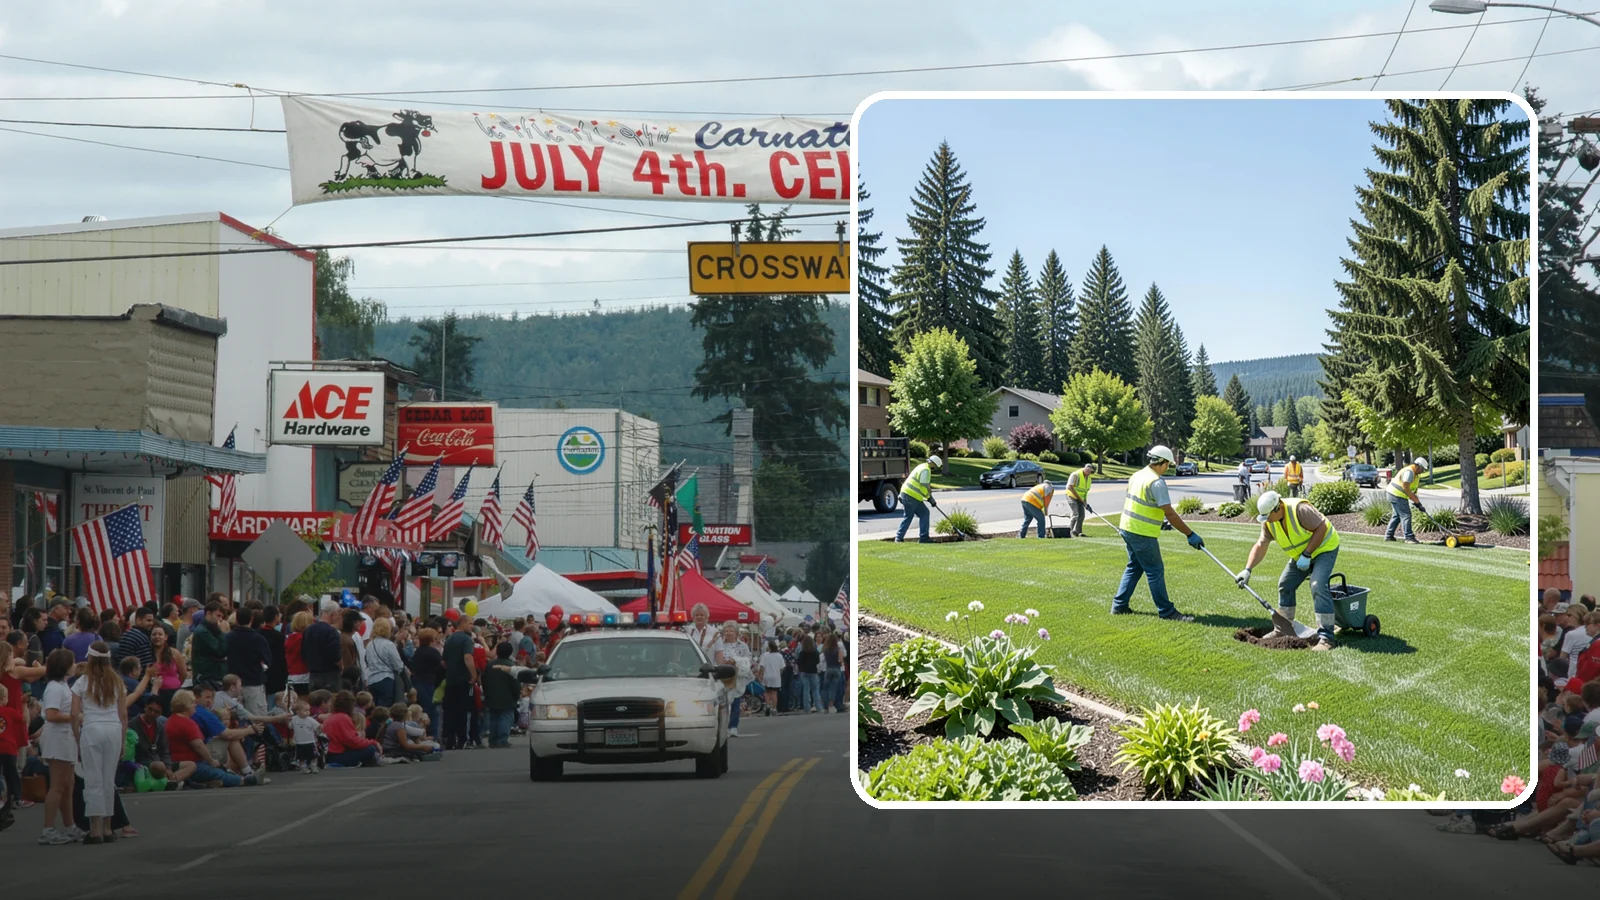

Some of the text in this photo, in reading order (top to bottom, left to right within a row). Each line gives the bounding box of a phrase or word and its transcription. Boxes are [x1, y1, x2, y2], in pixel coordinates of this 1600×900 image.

[695, 121, 850, 149] Carnat
[481, 140, 605, 192] JULY
[632, 150, 746, 196] 4th.
[697, 254, 850, 280] CROSSWA
[283, 380, 373, 420] ACE
[406, 409, 452, 422] CEDAR
[283, 421, 371, 436] Hardware
[353, 467, 386, 480] Simpl
[95, 485, 124, 494] Vincent
[126, 486, 135, 494] de
[137, 486, 155, 495] Paul
[688, 526, 741, 535] CRNATION
[699, 535, 730, 543] GLASS
